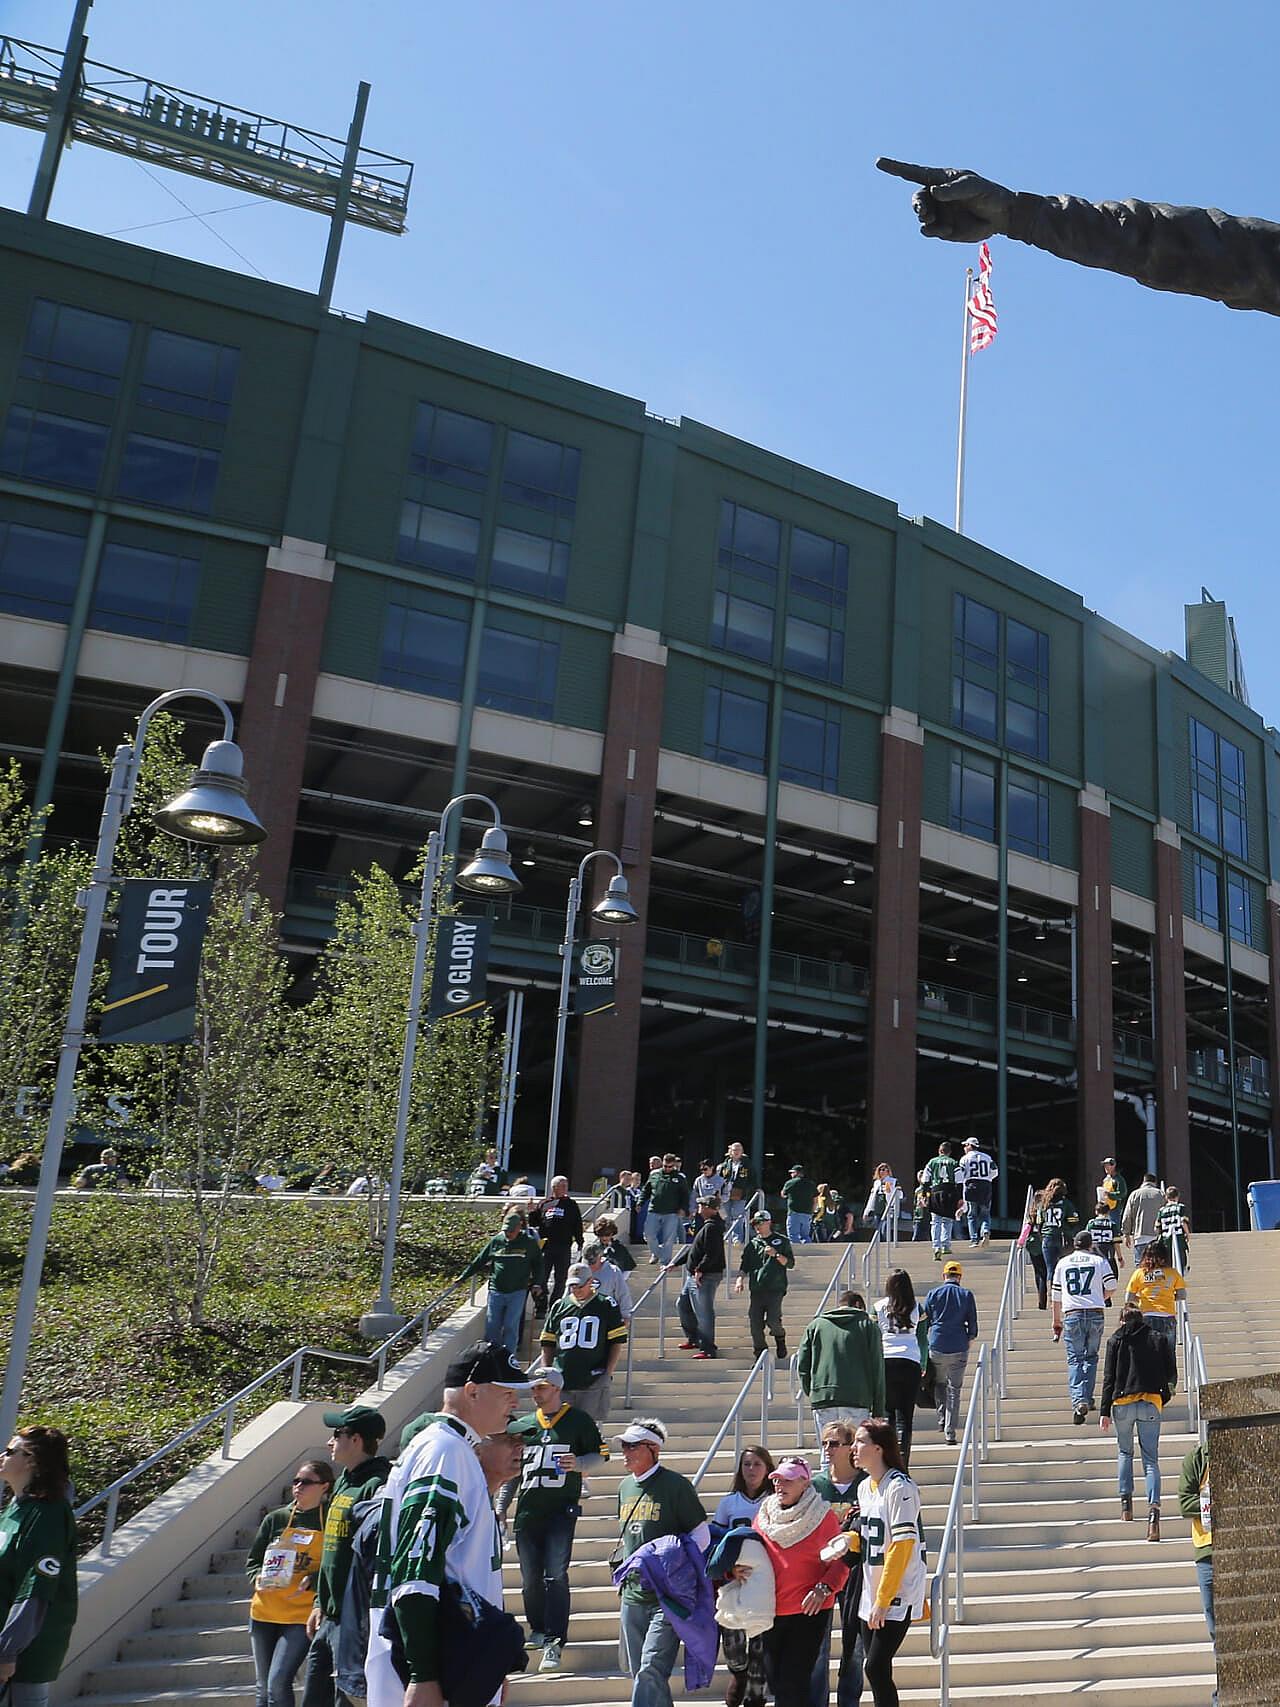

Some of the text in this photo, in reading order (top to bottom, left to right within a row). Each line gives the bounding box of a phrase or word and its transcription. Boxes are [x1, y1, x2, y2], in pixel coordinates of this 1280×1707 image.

[136, 888, 188, 974] TOUR
[449, 921, 477, 984] GLORY
[579, 976, 614, 986] WELCOME
[969, 1160, 989, 1178] 20
[1065, 1266, 1096, 1295] 87
[559, 1315, 600, 1350] 80
[521, 1444, 571, 1490] 25
